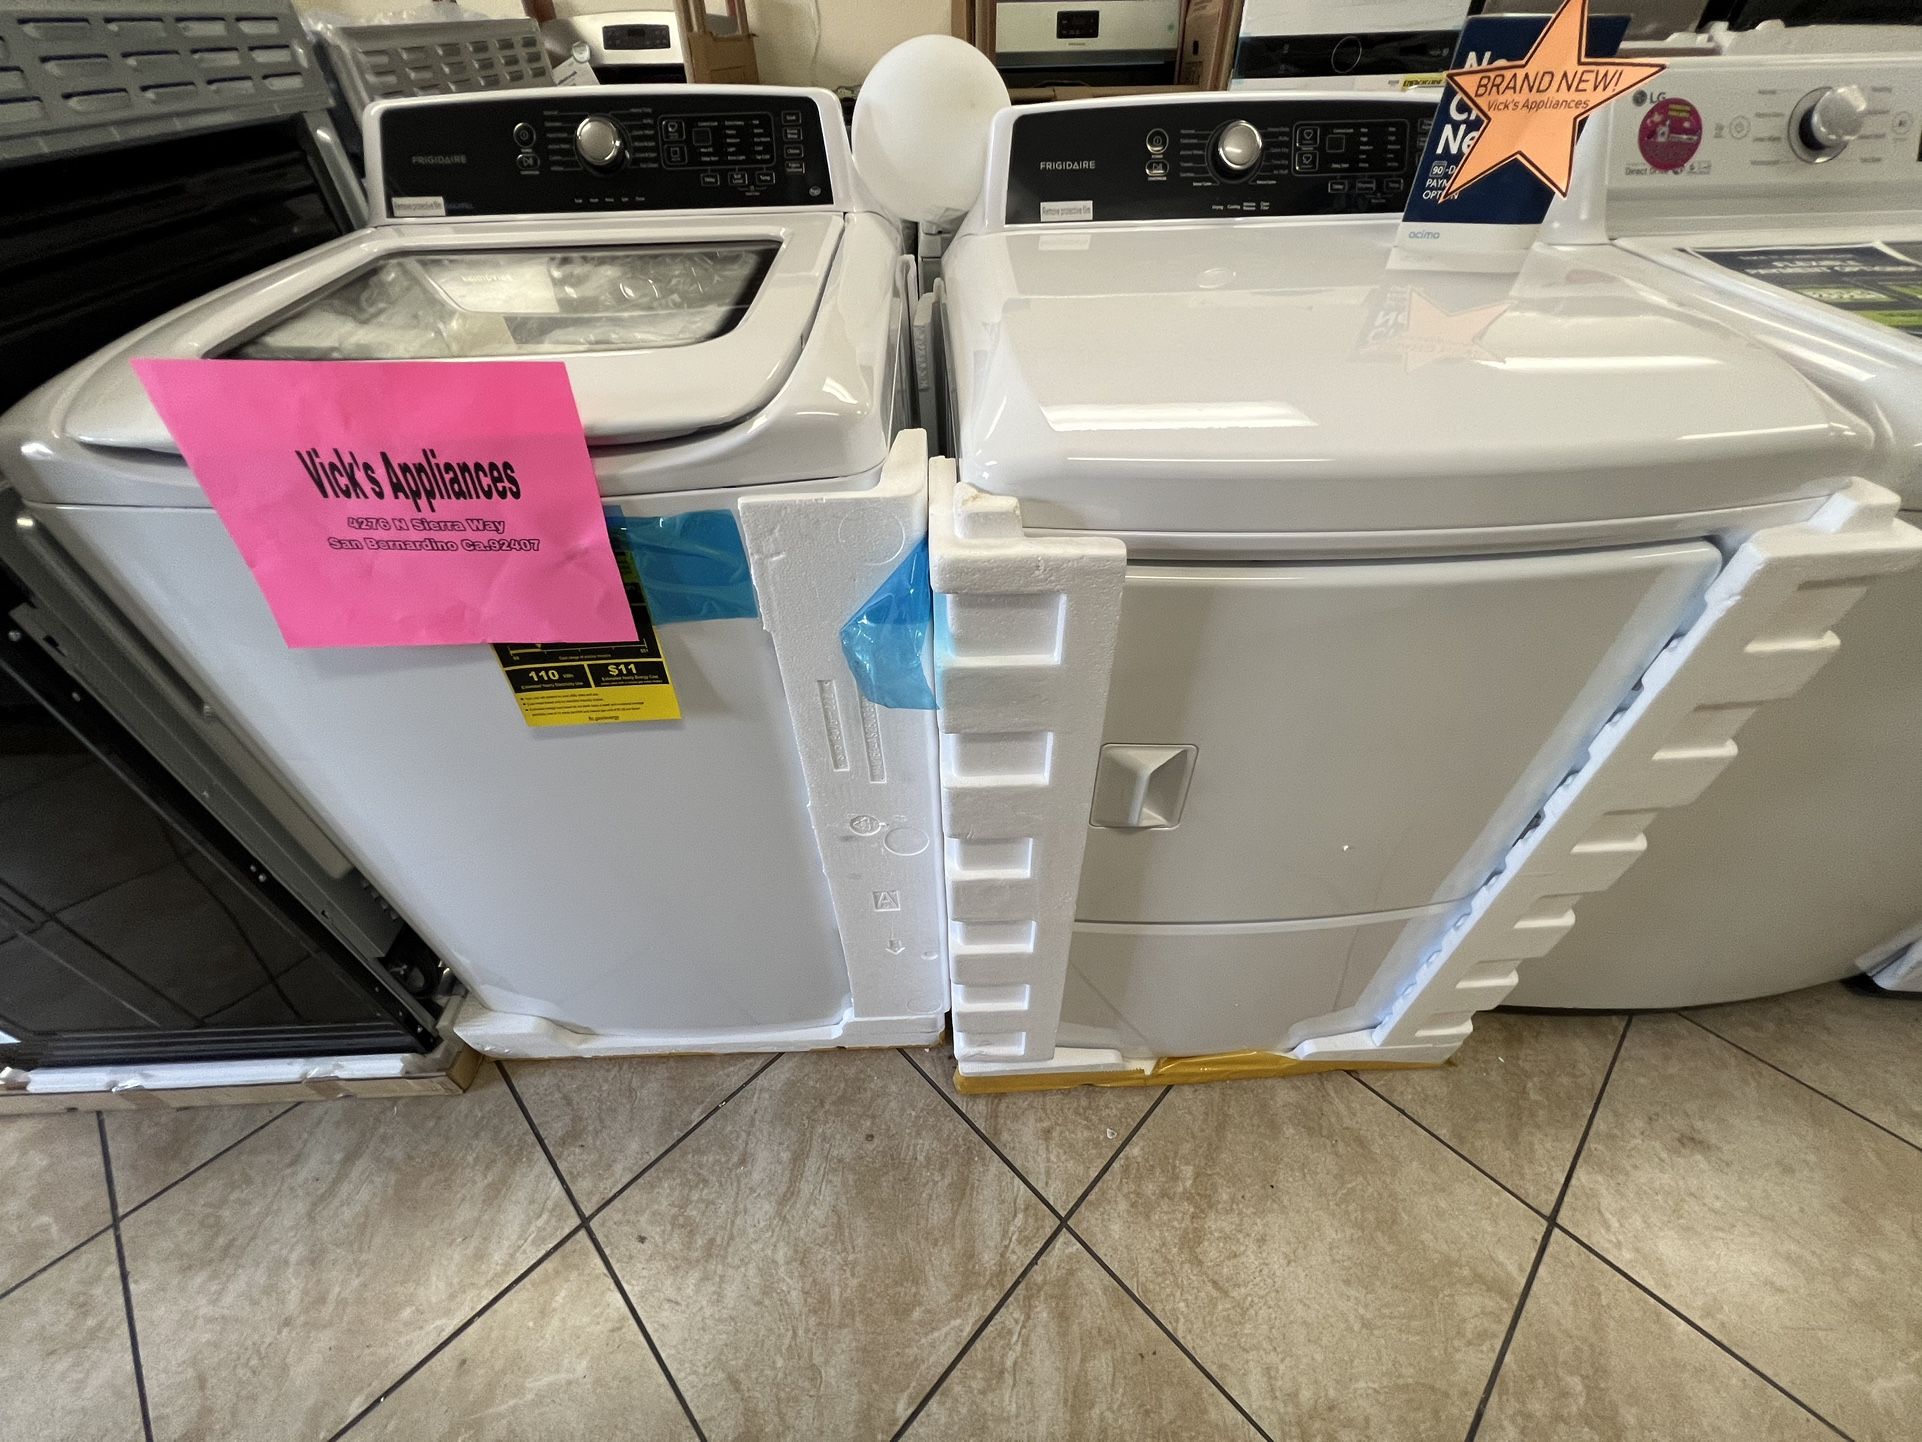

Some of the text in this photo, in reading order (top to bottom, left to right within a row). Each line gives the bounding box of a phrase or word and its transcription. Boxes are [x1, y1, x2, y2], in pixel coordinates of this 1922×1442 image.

[1474, 69, 1623, 97] BRAND NEW!
[1650, 92, 1666, 104] LG
[1487, 97, 1590, 113] Vick's Appliances
[412, 154, 467, 165] FRIGIDAIRE
[1040, 160, 1096, 170] FRIGIDAIRE
[1422, 190, 1459, 200] OPTN
[1408, 230, 1440, 239] acima
[295, 447, 521, 512] Vick's Appliances
[347, 517, 505, 534] 4276 N Sierra Way
[327, 537, 541, 551] San Bernardino Ca.92407
[608, 663, 637, 676] $11
[528, 670, 559, 682] 110
